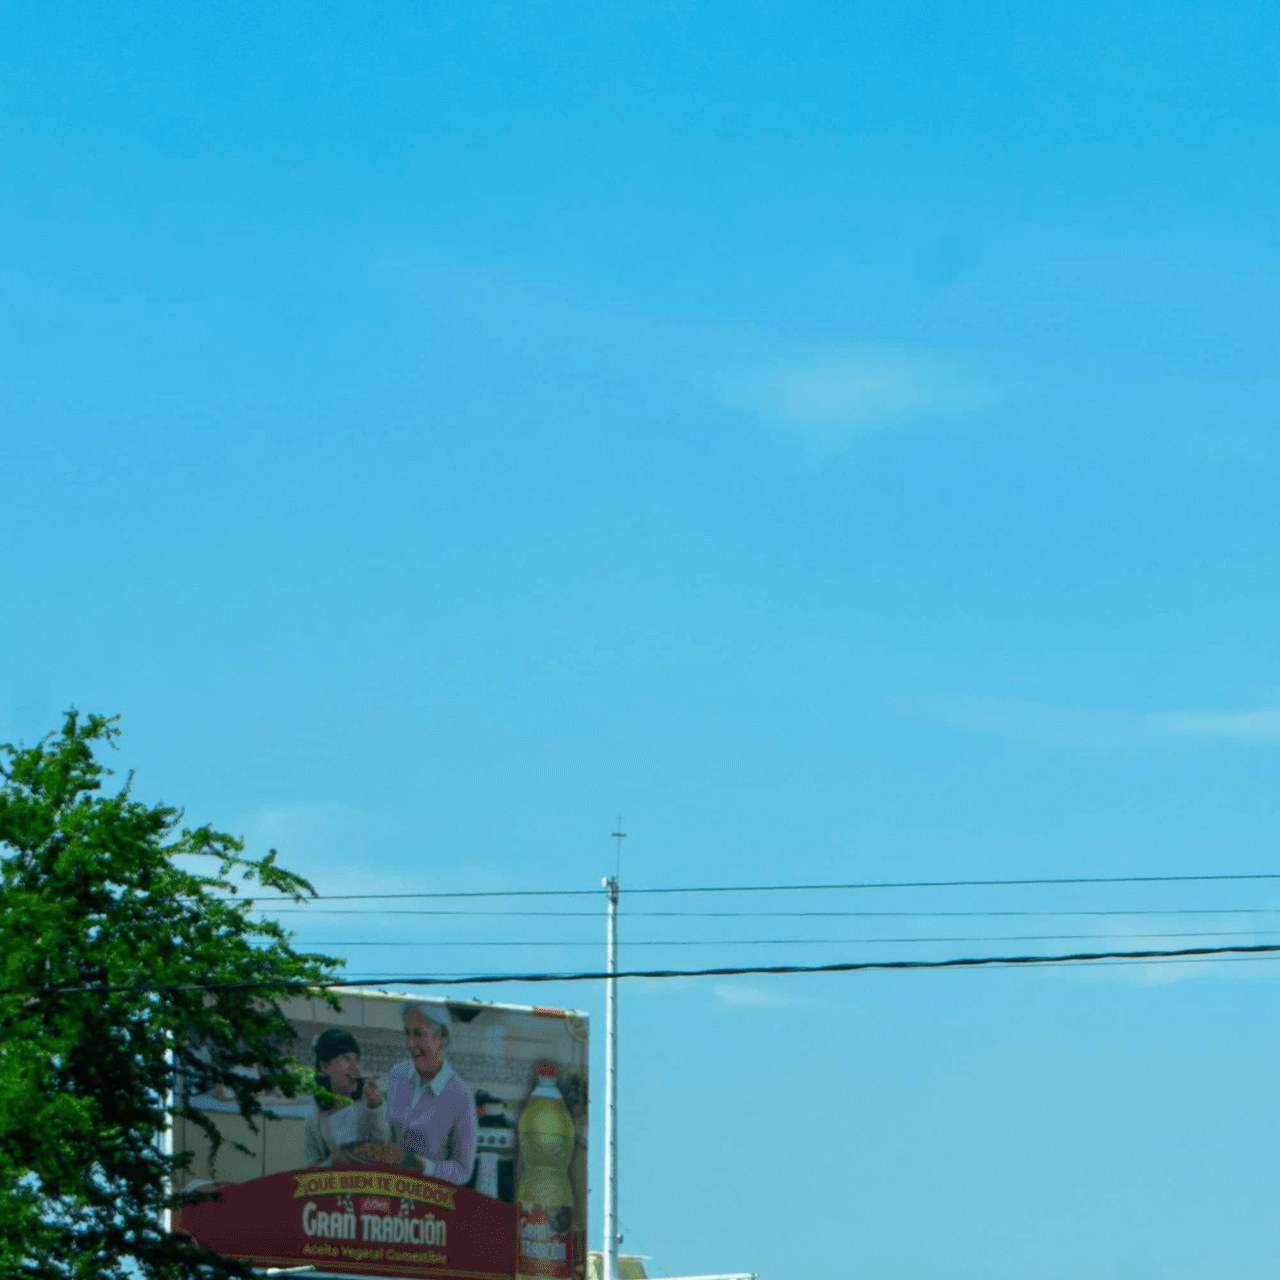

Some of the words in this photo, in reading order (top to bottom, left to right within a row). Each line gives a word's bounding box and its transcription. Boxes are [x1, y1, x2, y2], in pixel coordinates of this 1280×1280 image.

[340, 1175, 373, 1190] BIEN
[377, 1176, 391, 1190] TE
[302, 1243, 340, 1257] Aceite
[341, 1246, 385, 1261] Vegetal
